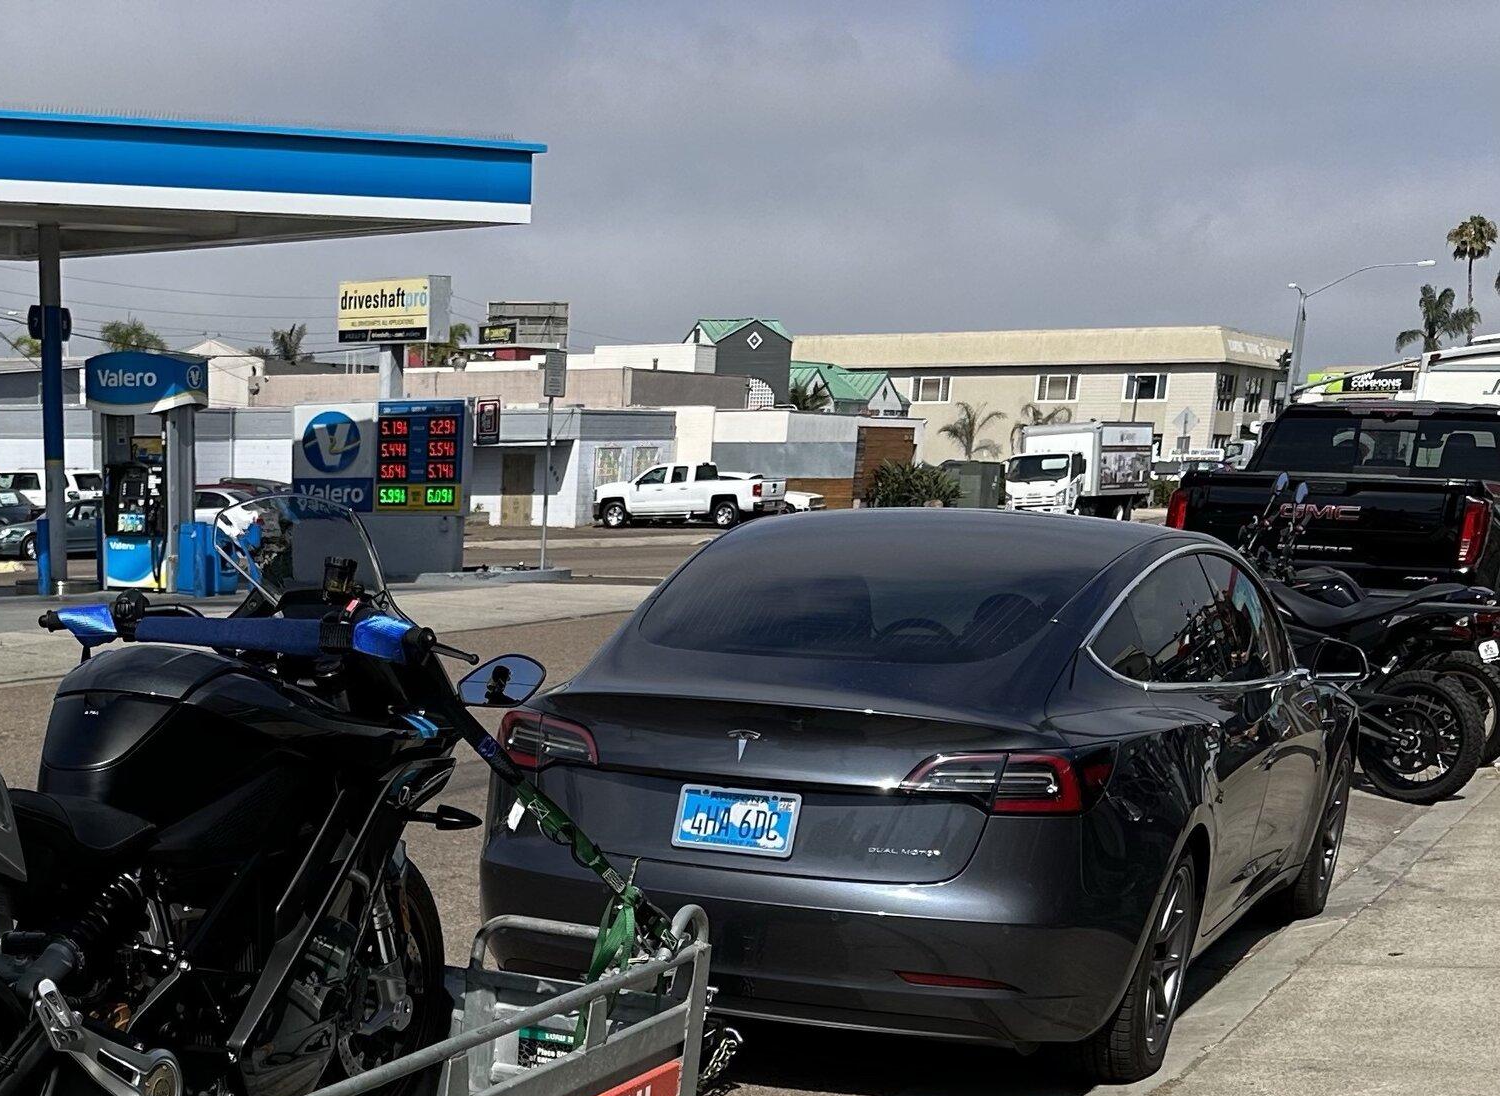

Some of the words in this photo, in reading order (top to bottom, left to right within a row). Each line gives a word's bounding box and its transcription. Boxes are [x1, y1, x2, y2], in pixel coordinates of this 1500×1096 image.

[340, 287, 428, 312] driveshaftpro
[97, 368, 158, 388] Valero
[1350, 378, 1403, 388] COMMONS
[299, 484, 365, 504] Valero
[1279, 502, 1362, 521] GMC
[109, 541, 136, 551] Valero
[691, 804, 731, 837] 4HA
[738, 809, 782, 842] 6DC
[868, 847, 898, 855] DUAL
